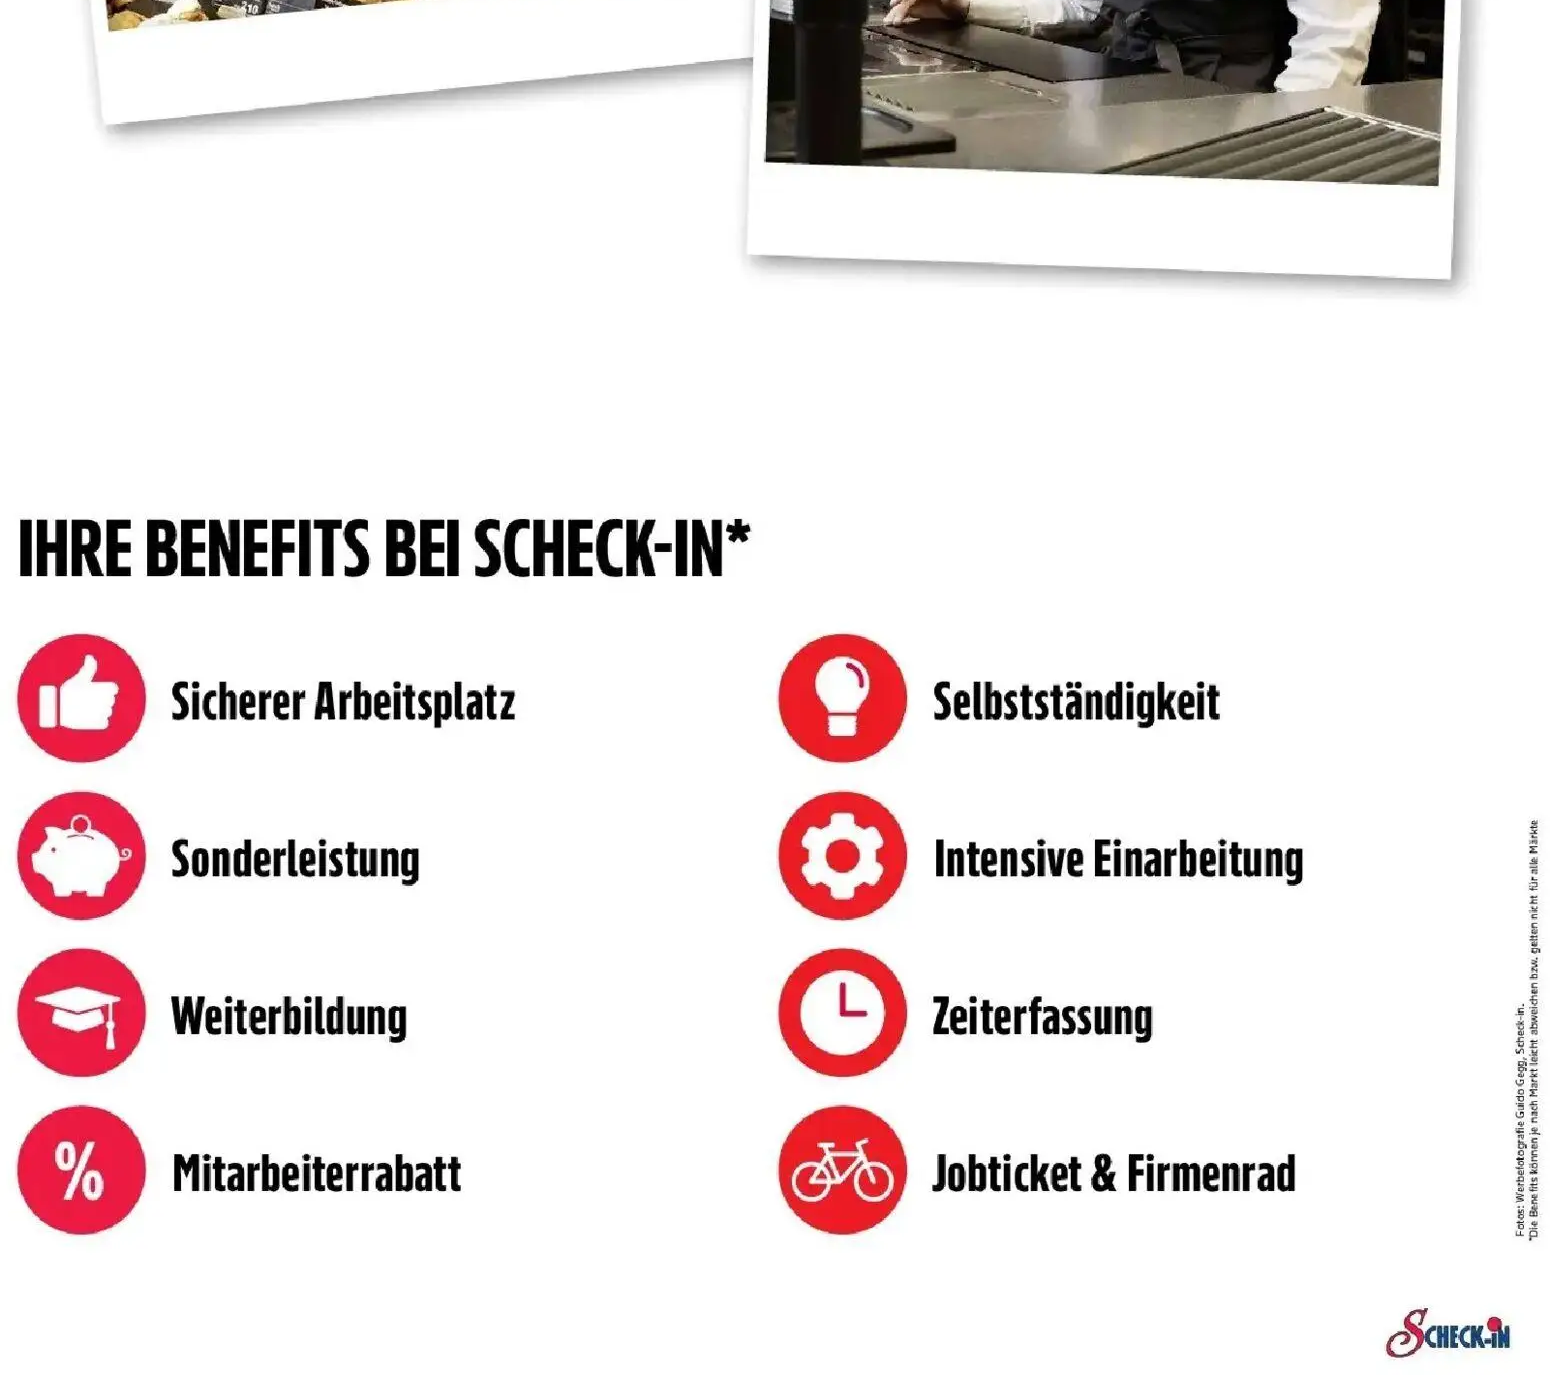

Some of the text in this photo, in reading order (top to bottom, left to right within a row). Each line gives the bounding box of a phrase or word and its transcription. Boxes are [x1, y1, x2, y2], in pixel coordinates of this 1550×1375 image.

[20, 520, 131, 576] IHRE
[147, 519, 369, 577] BENEFITS
[386, 520, 459, 576] BEI
[172, 681, 515, 728] Sicherer Arbeitsplatz
[934, 681, 1220, 728] Selbstständigkeit
[1528, 819, 1538, 854] Märkte
[172, 839, 419, 886] Sonderleistung
[936, 839, 1302, 886] Intensive Einarbeitung
[1528, 857, 1538, 875] alle
[1528, 876, 1538, 891] für
[1528, 896, 1538, 919] nicht
[1528, 923, 1540, 954] gelten
[1528, 957, 1538, 980] bzw.
[171, 996, 406, 1043] Weiterbildung
[933, 996, 1151, 1043] Zeiterfassung
[1528, 983, 1538, 1036] abweichen
[1528, 1040, 1538, 1067] leicht
[1528, 1069, 1538, 1097] Markt
[1515, 1004, 1527, 1237] Fotos: Werbefotografie Guido Gegg, Scheck-in.
[1528, 1101, 1538, 1124] nach
[1528, 1127, 1540, 1136] je
[55, 1142, 103, 1200] %
[174, 1154, 461, 1192] Mitarbeiterrabatt
[932, 1154, 1295, 1192] Jobticket & Firmenrad
[1528, 1138, 1538, 1175] können
[1528, 1177, 1538, 1217] Benefits
